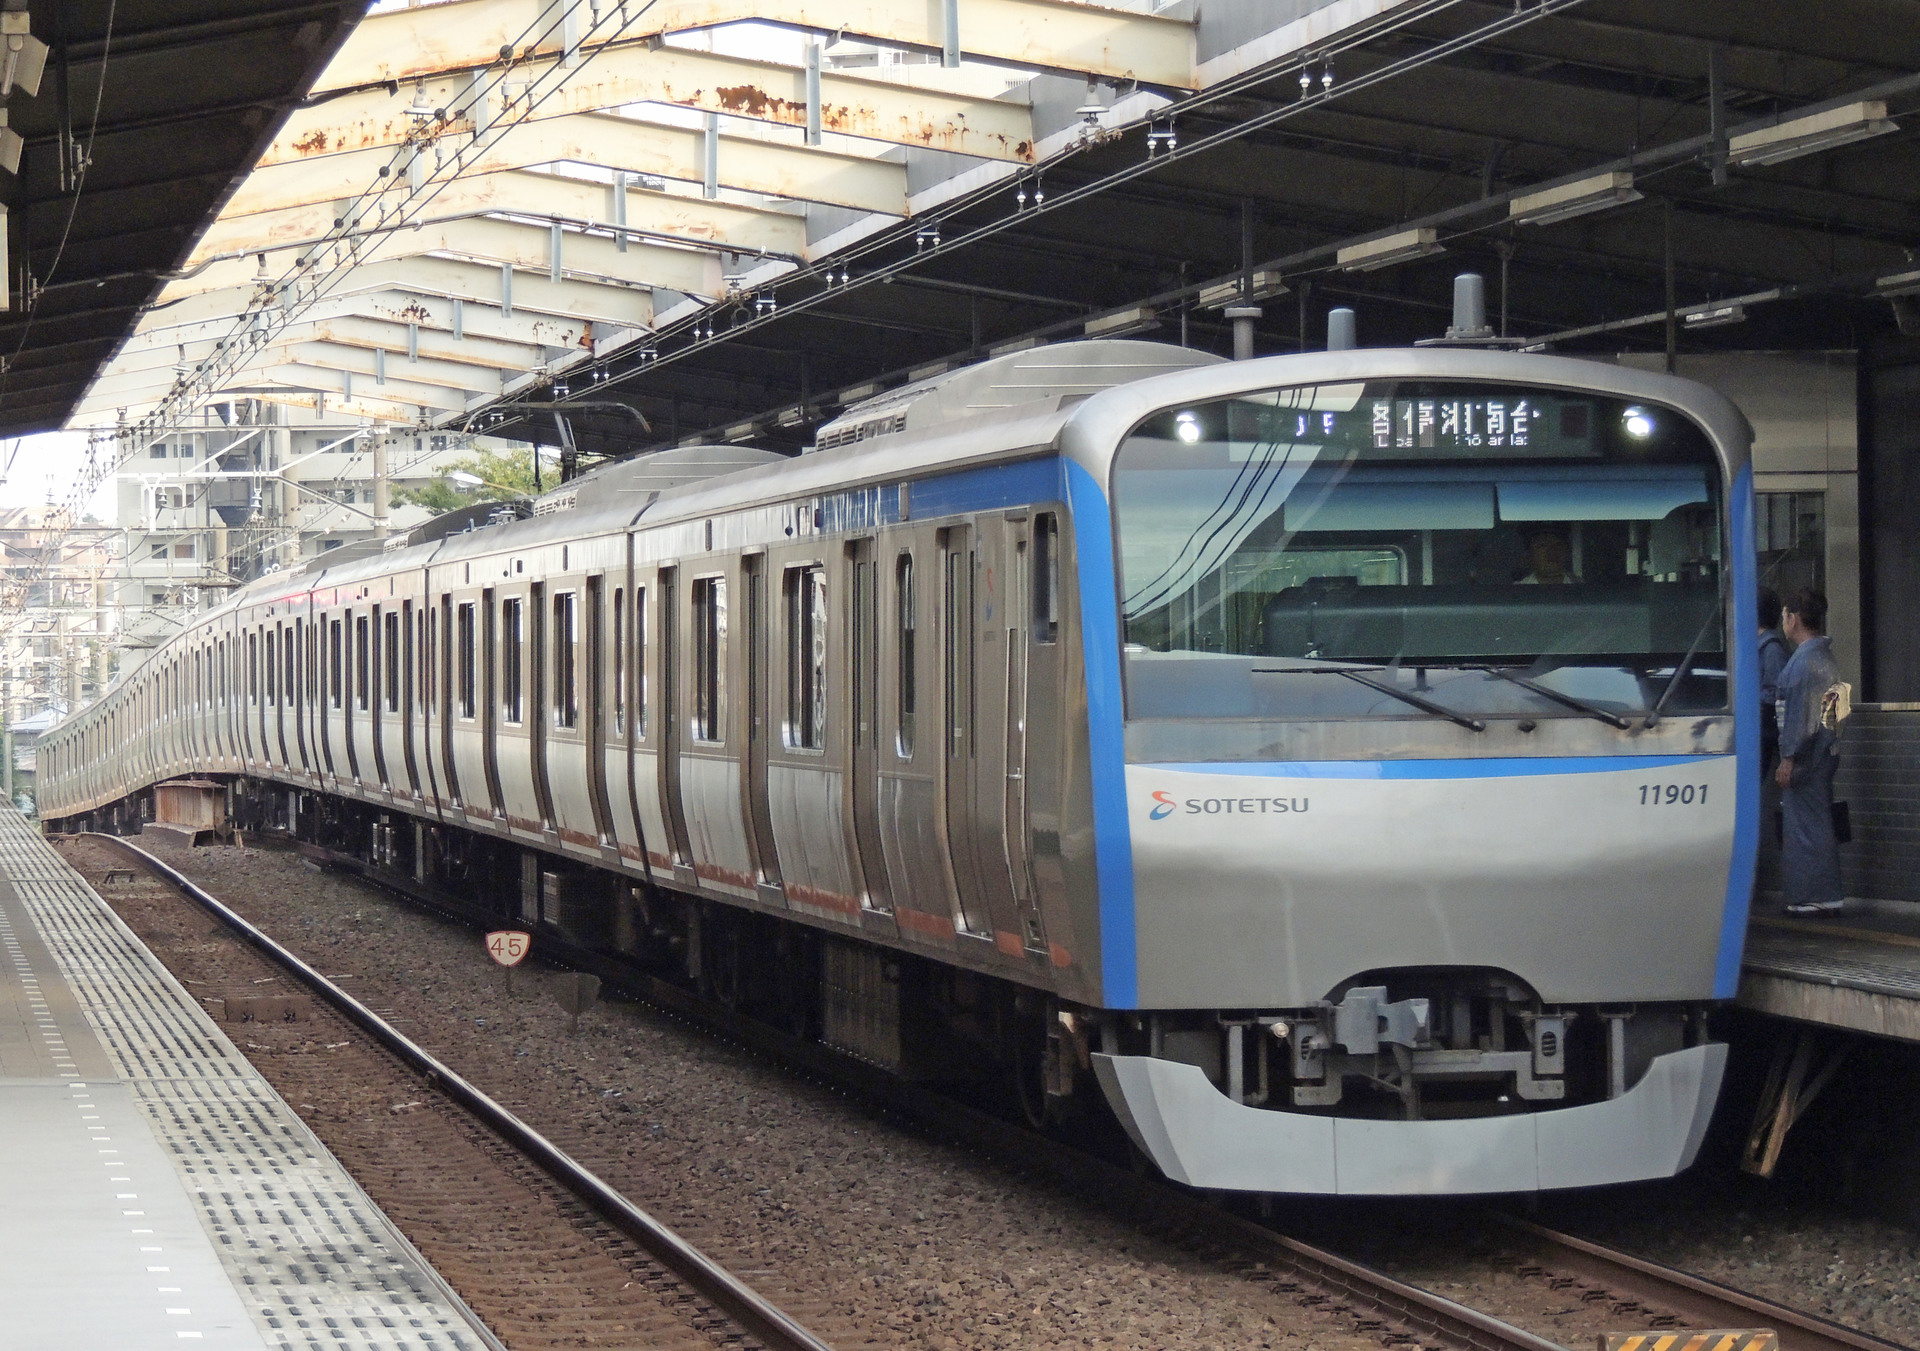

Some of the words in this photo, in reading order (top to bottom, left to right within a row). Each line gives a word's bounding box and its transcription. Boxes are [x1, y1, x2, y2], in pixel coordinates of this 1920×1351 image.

[1638, 783, 1708, 805] 11901
[1184, 797, 1310, 815] SOTETSU
[490, 937, 522, 957] 45
